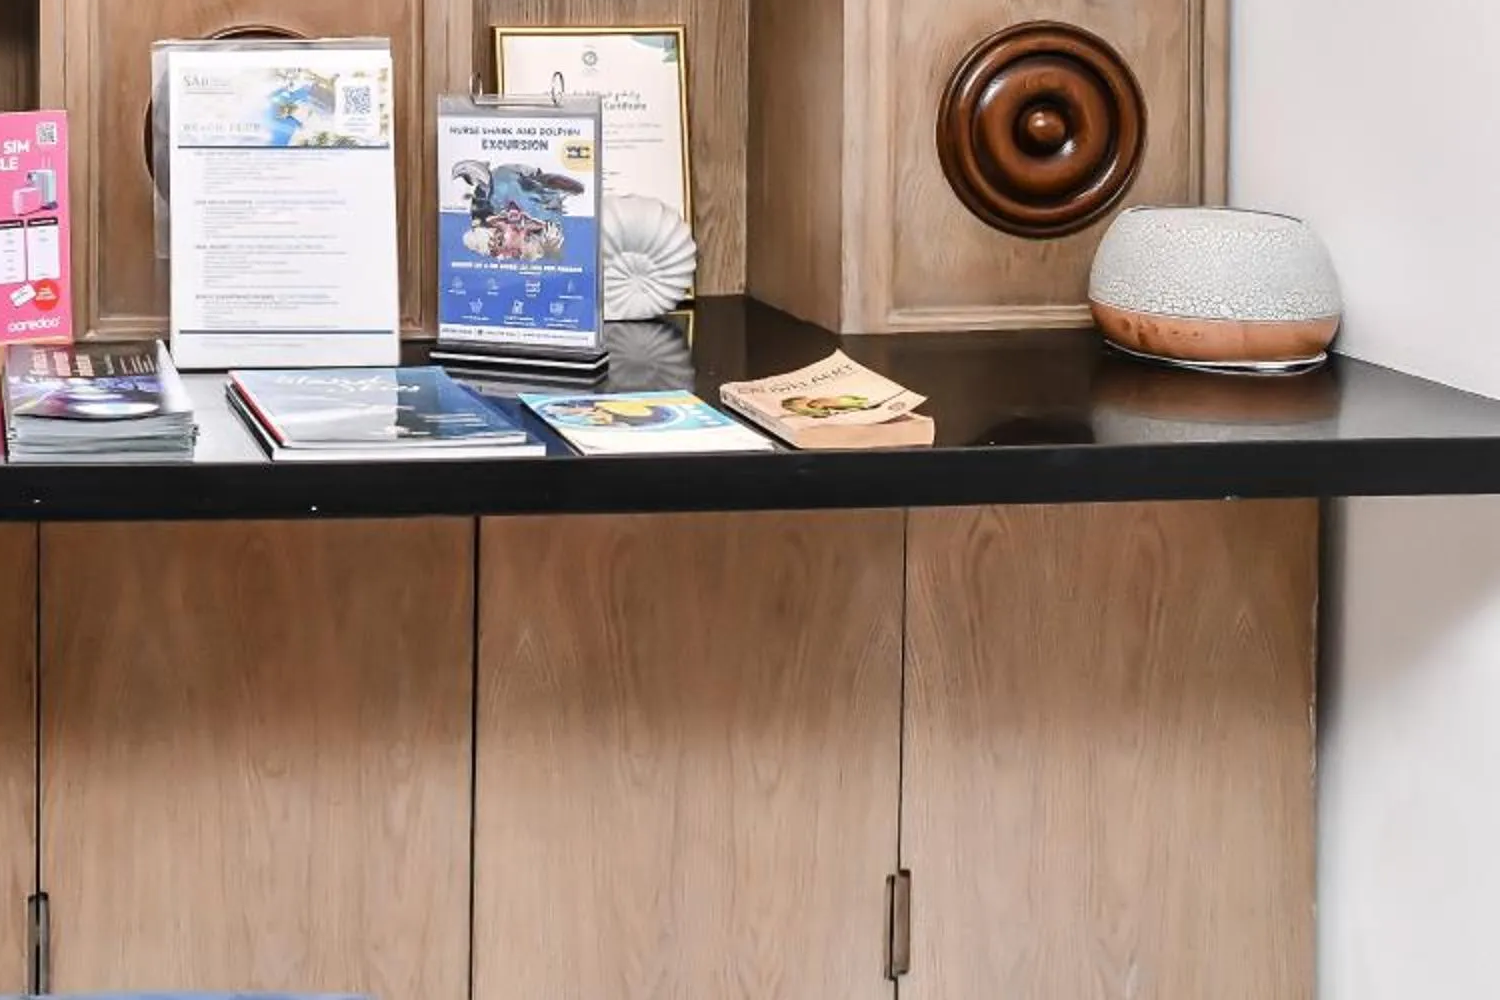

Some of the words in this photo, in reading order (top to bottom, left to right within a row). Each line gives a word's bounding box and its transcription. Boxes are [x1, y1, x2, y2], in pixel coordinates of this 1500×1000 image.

[449, 126, 480, 136] NURSE
[482, 127, 513, 136] SHARK
[515, 127, 538, 136] AND
[539, 127, 581, 137] DOLPHIN
[3, 139, 30, 155] SIM
[481, 139, 549, 151] EXCURSION
[8, 317, 60, 332] ooredoo
